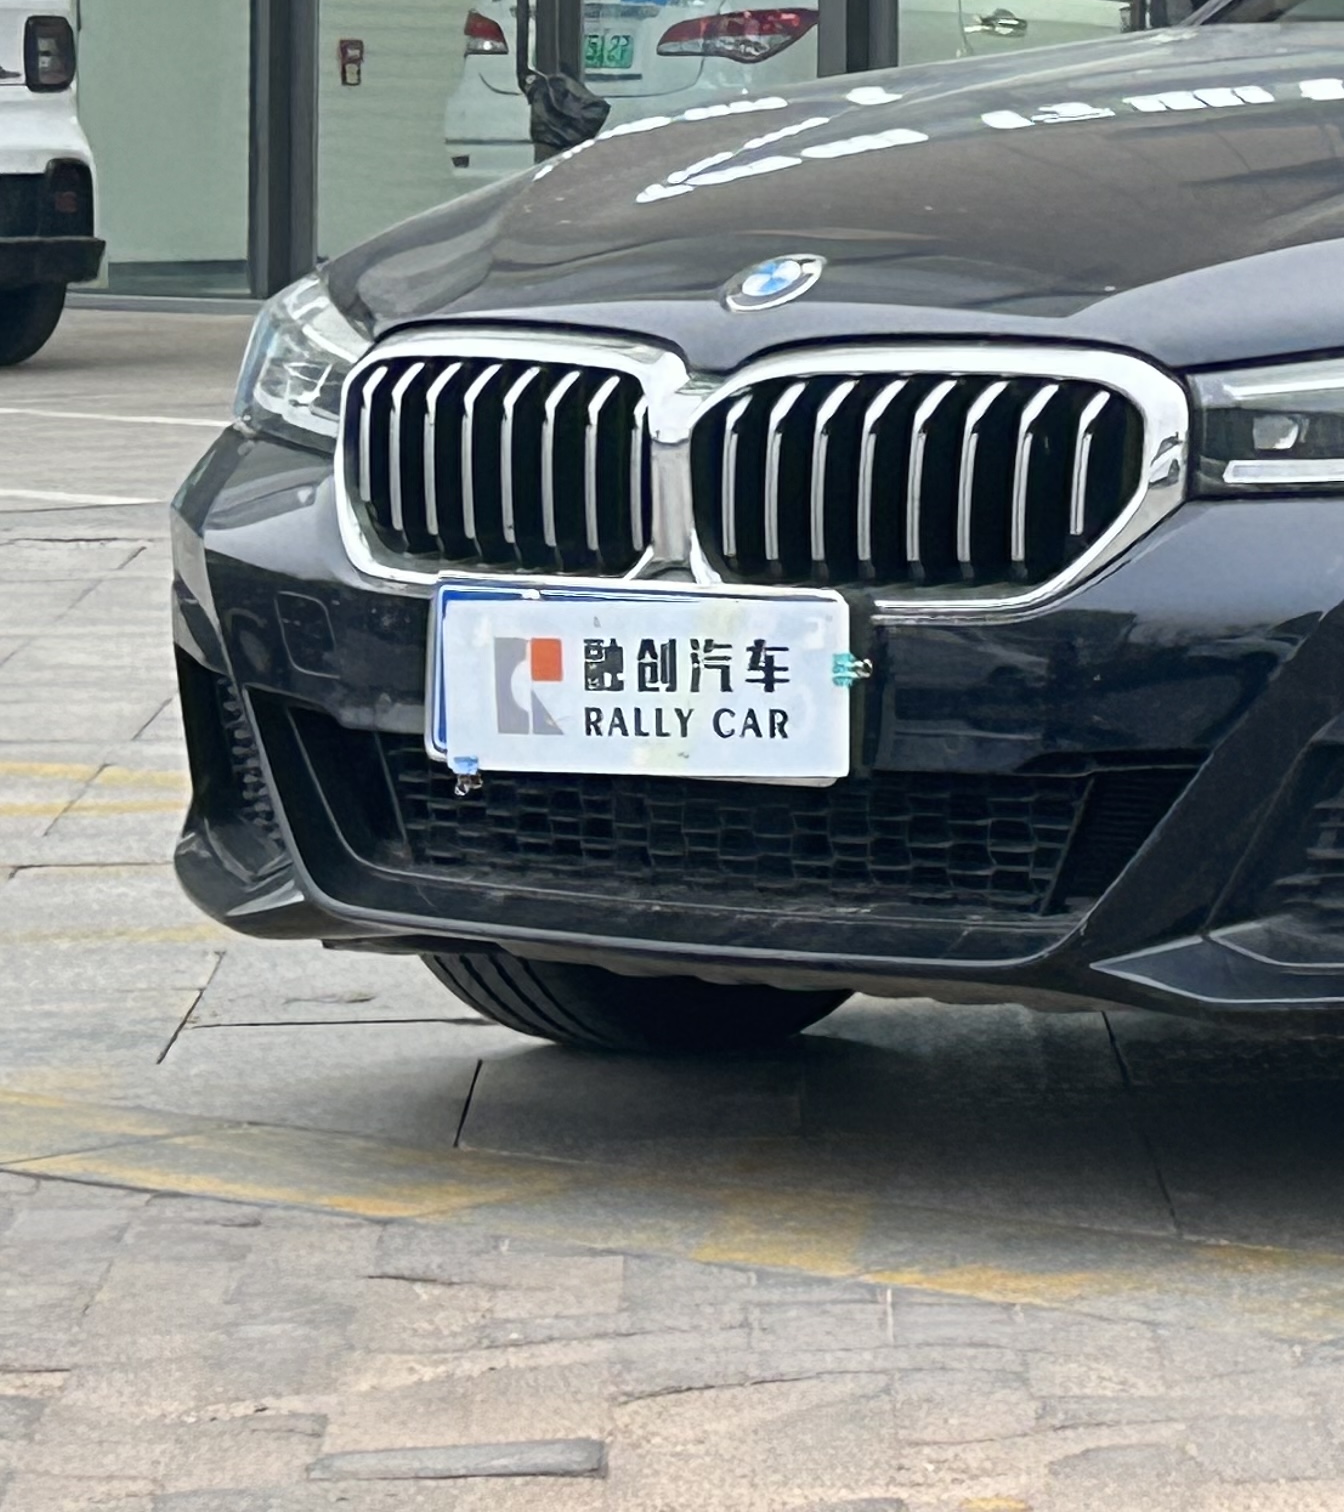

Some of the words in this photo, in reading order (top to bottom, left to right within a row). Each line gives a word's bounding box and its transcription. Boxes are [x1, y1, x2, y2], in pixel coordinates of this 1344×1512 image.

[583, 638, 790, 692] 融创汽车
[584, 706, 694, 738] RALLY
[712, 707, 789, 739] CAR
